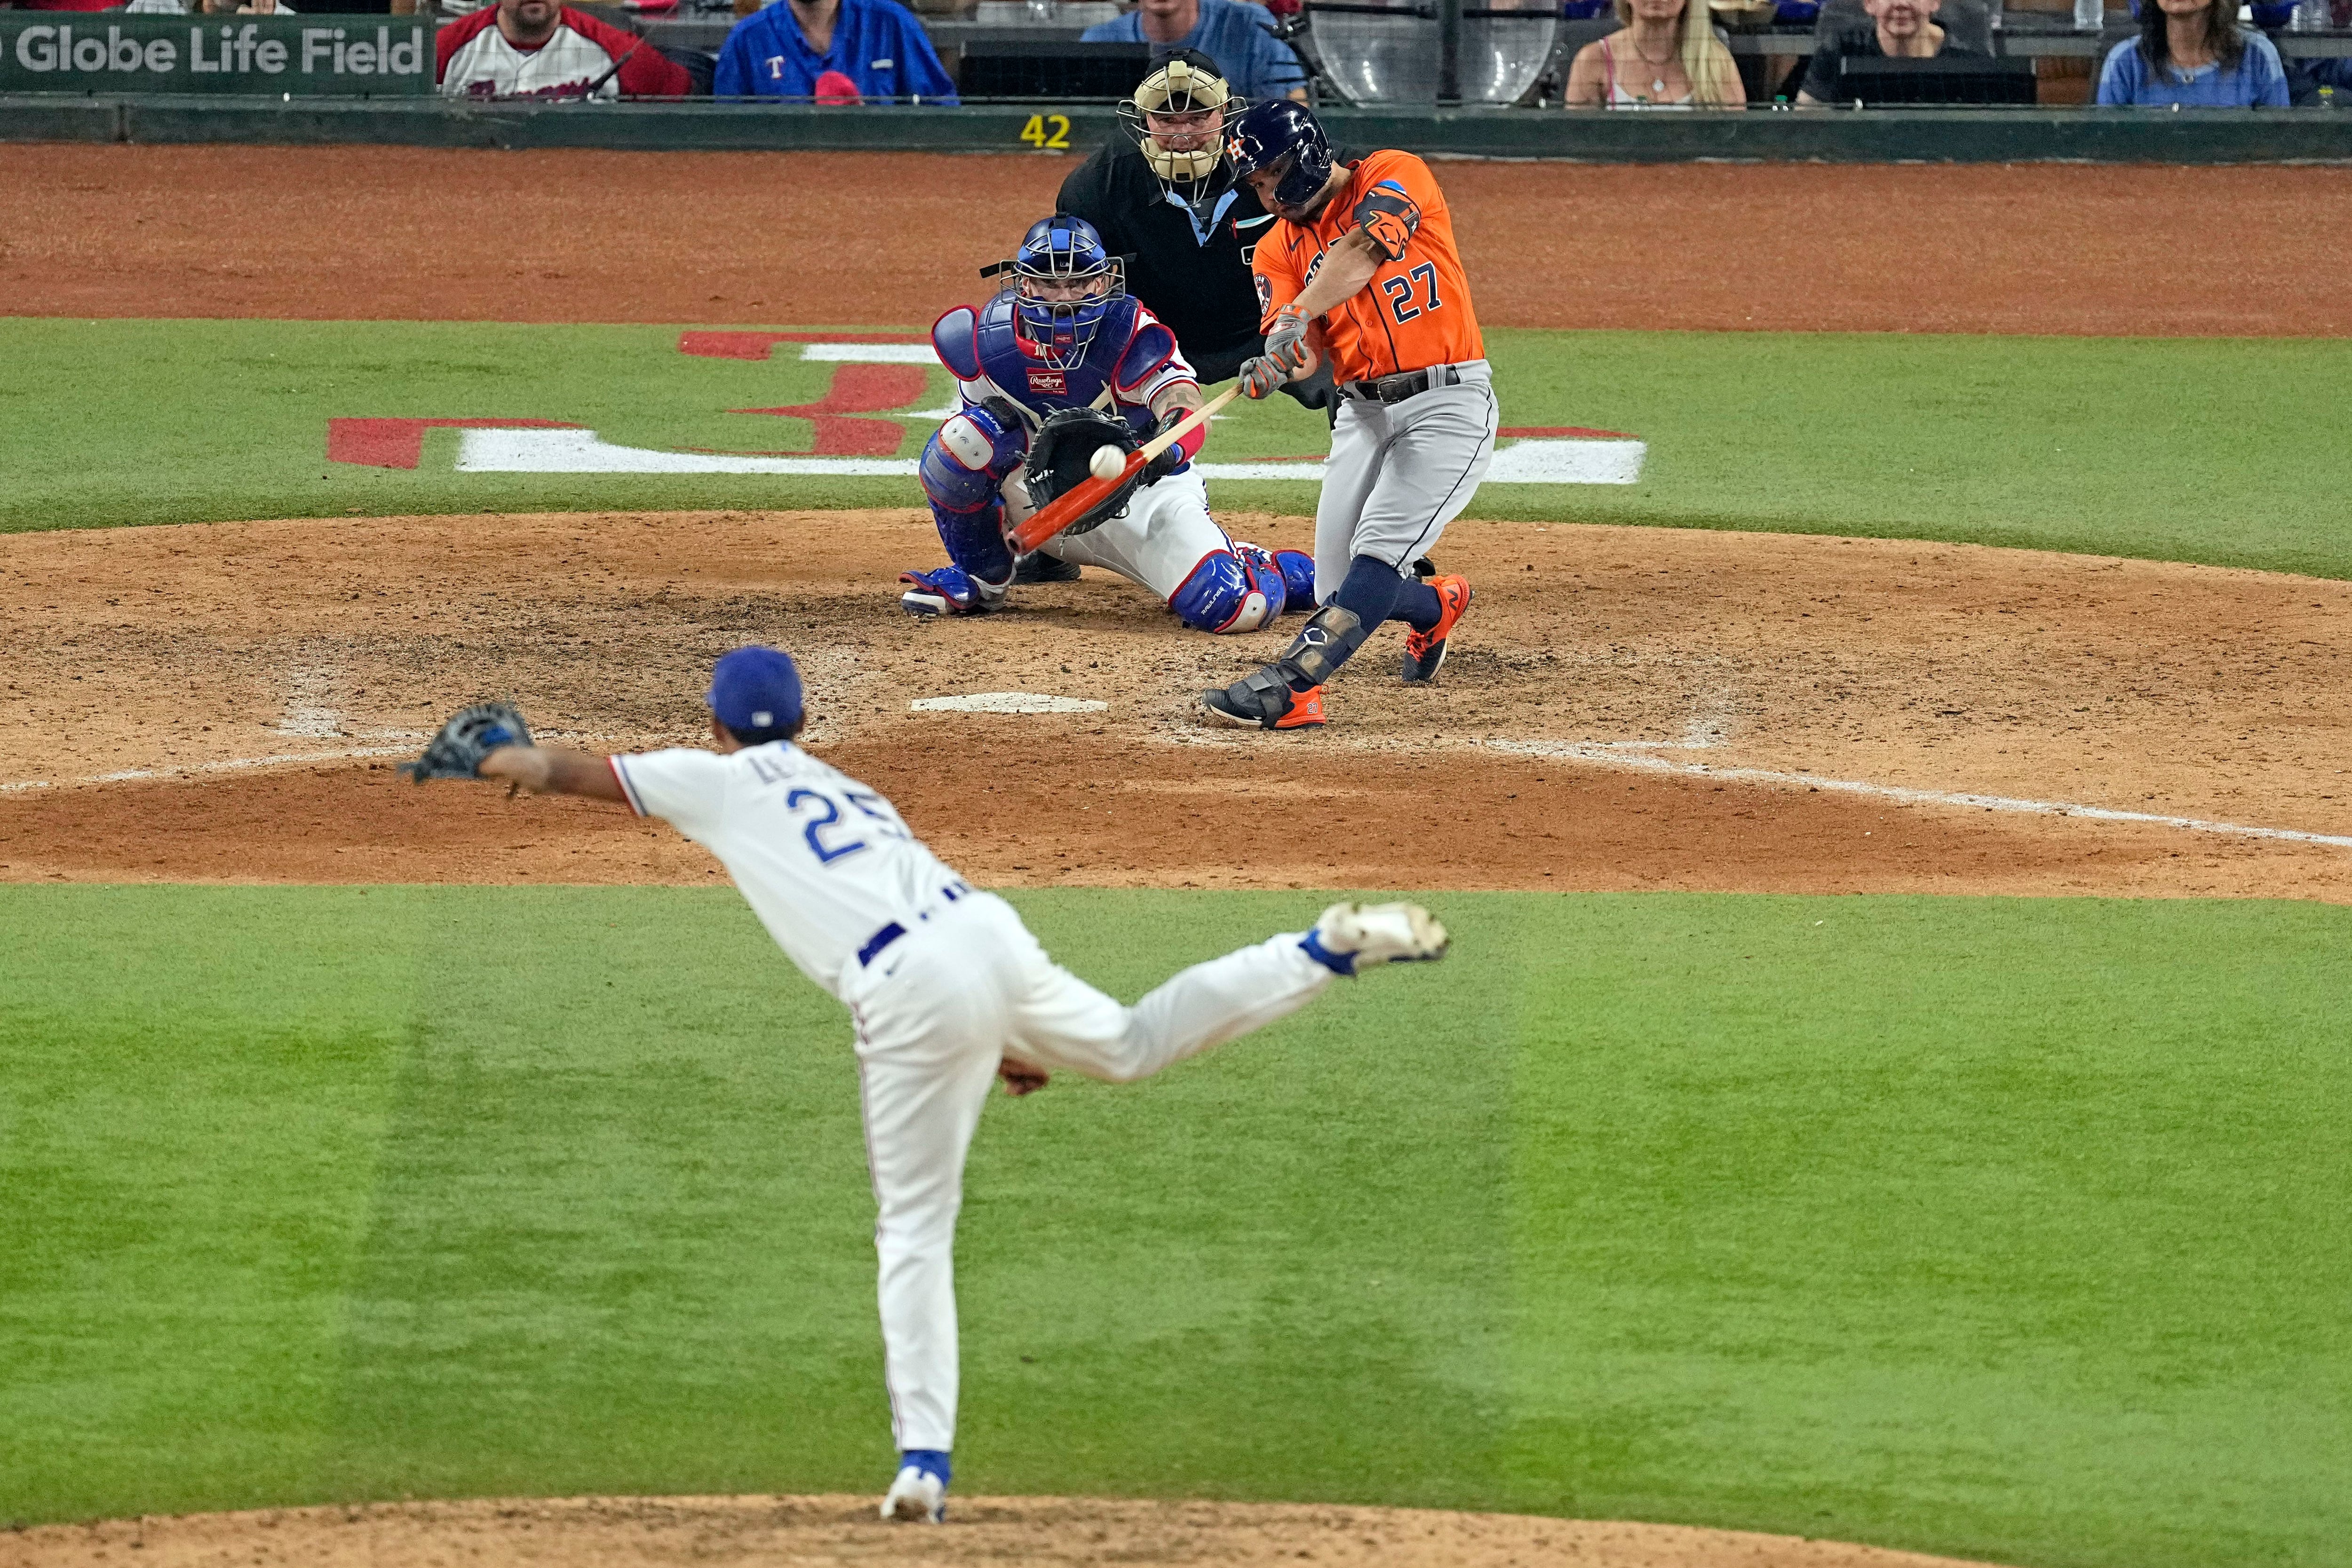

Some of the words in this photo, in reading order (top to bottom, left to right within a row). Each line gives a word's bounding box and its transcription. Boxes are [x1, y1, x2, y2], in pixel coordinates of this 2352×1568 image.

[16, 25, 176, 72] Globe
[191, 24, 288, 73] Life
[302, 26, 423, 74] Field
[766, 55, 784, 79] T
[1020, 114, 1071, 149] 42
[1381, 260, 1443, 325] 27
[1030, 376, 1063, 387] Rawlings
[1200, 586, 1224, 615] RAWLINGS
[1307, 702, 1318, 714] 27
